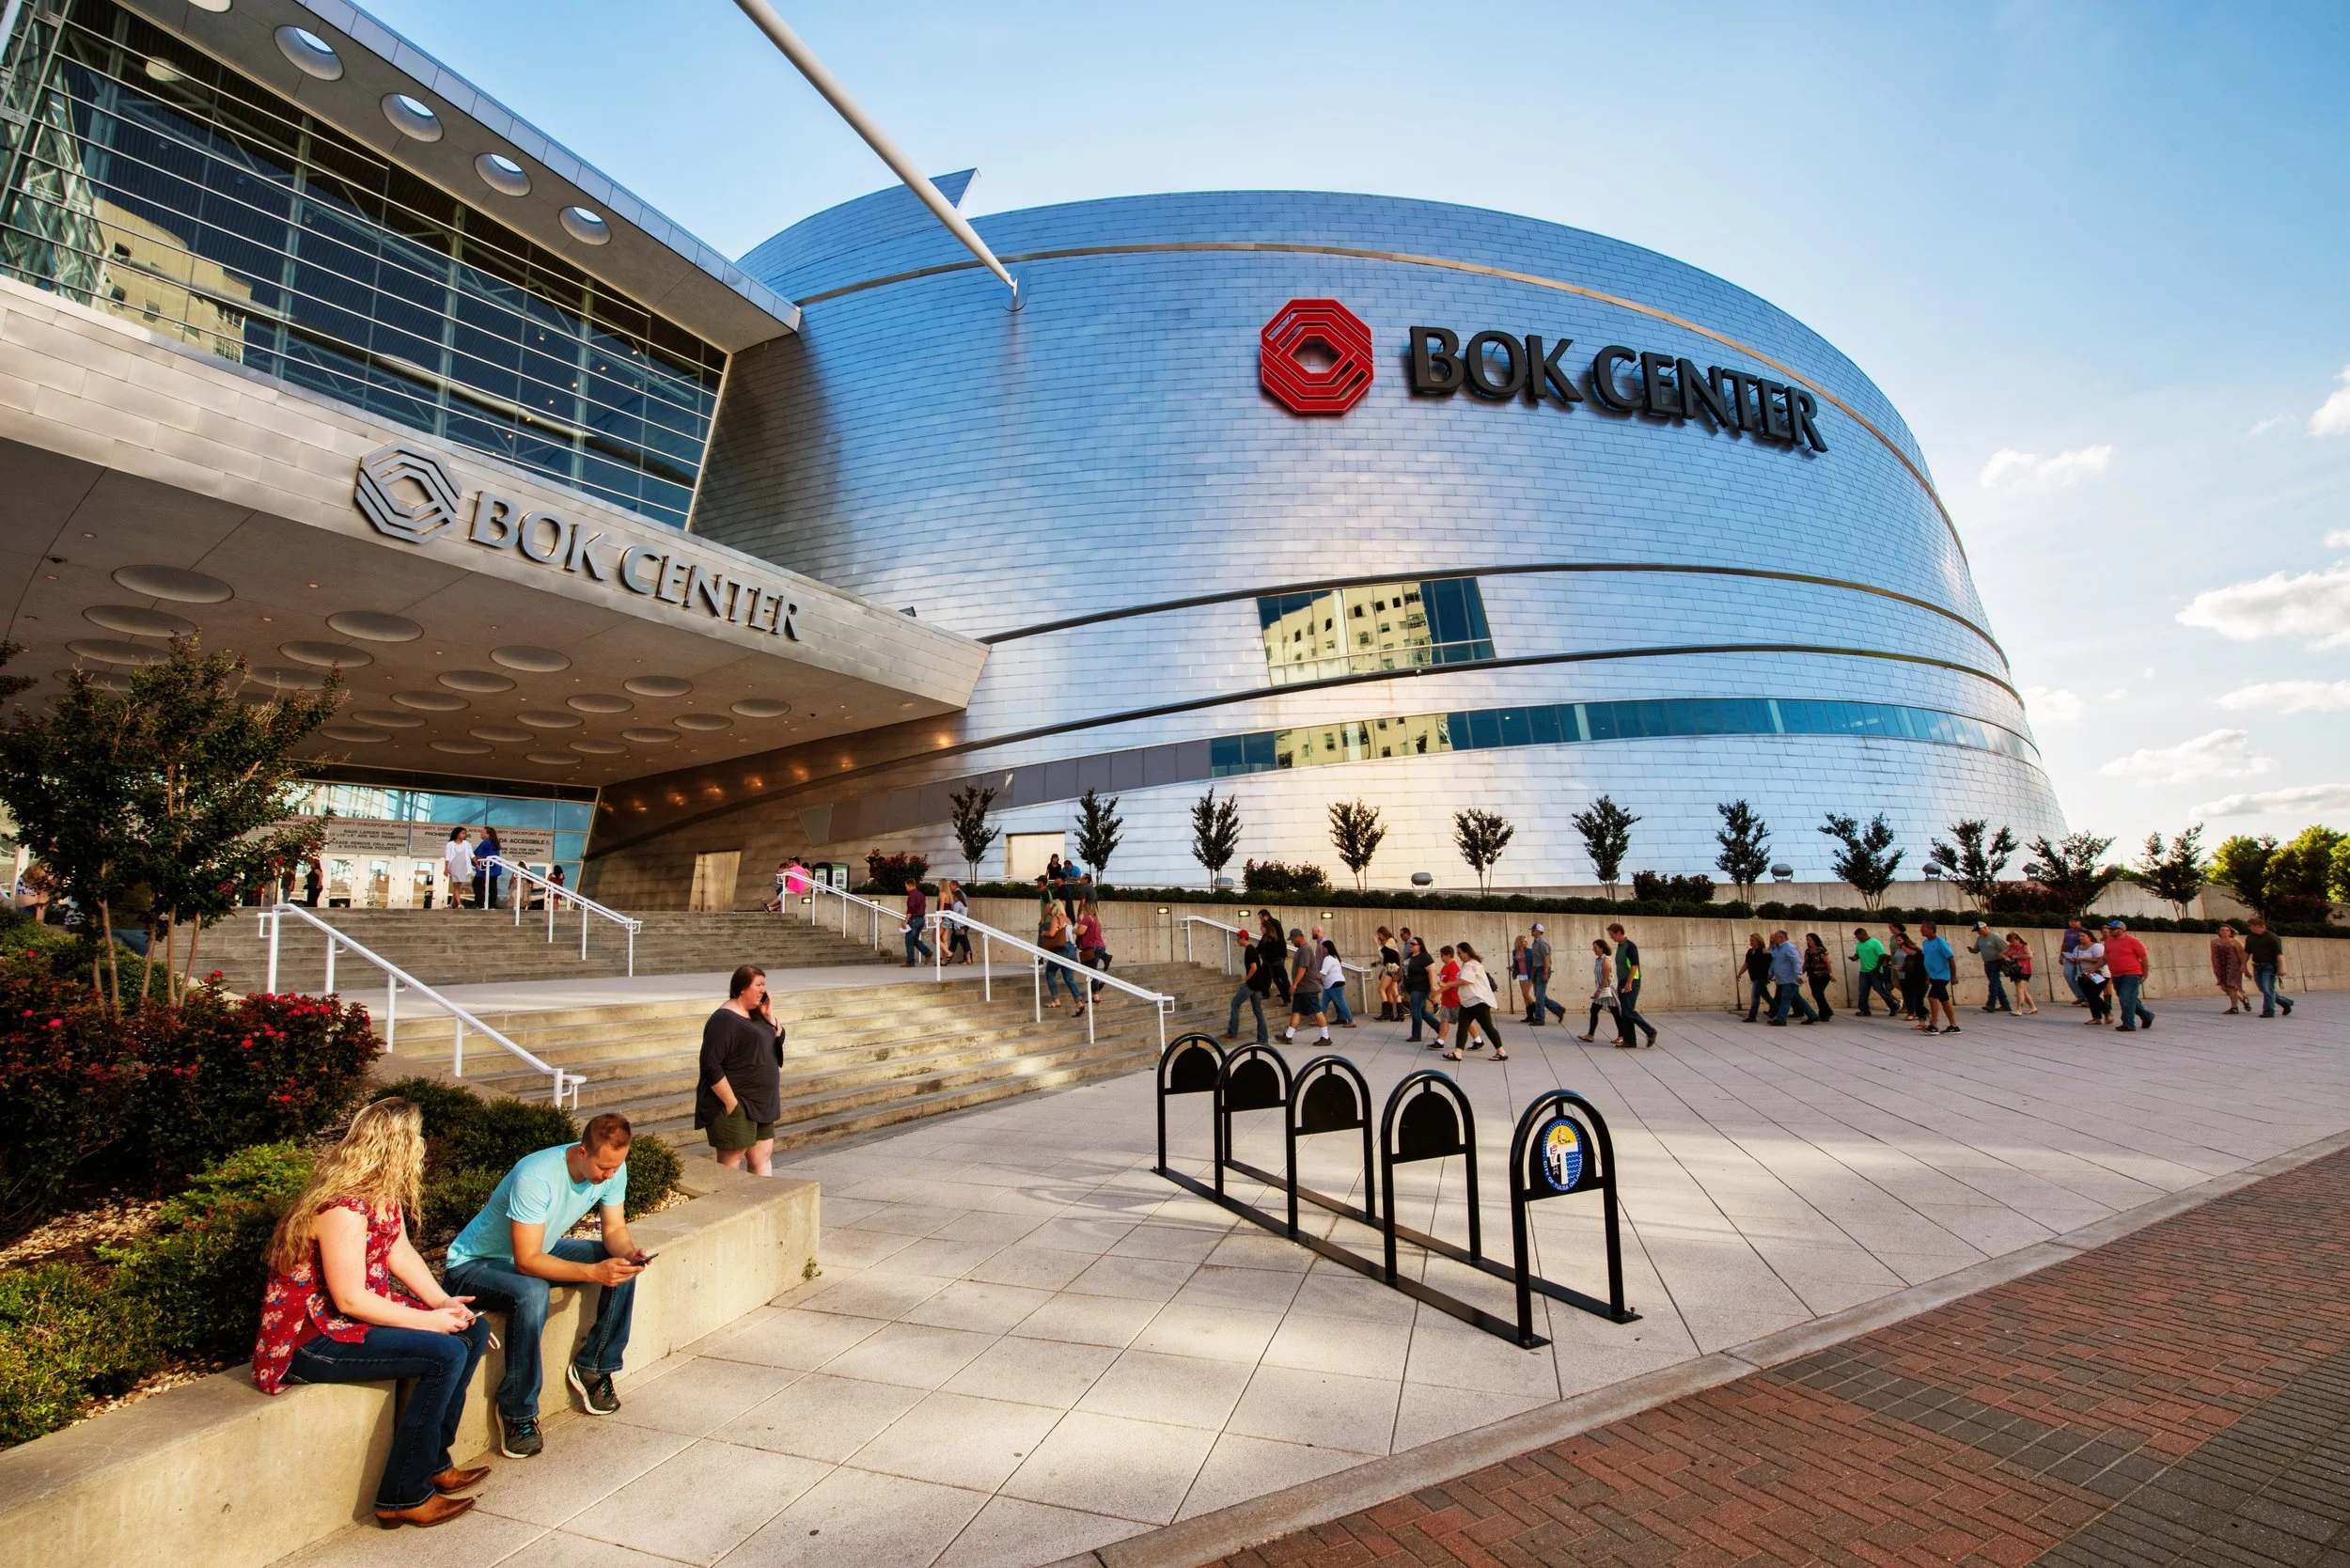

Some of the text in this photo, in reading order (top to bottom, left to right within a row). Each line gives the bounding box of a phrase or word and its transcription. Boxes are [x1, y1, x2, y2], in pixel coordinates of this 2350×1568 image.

[1410, 325, 1828, 453] BOK CENTER
[469, 490, 800, 641] BOK CENTER
[1554, 1183, 1570, 1191] TULSA
[1569, 1153, 1583, 1188] OKLAHOMA
